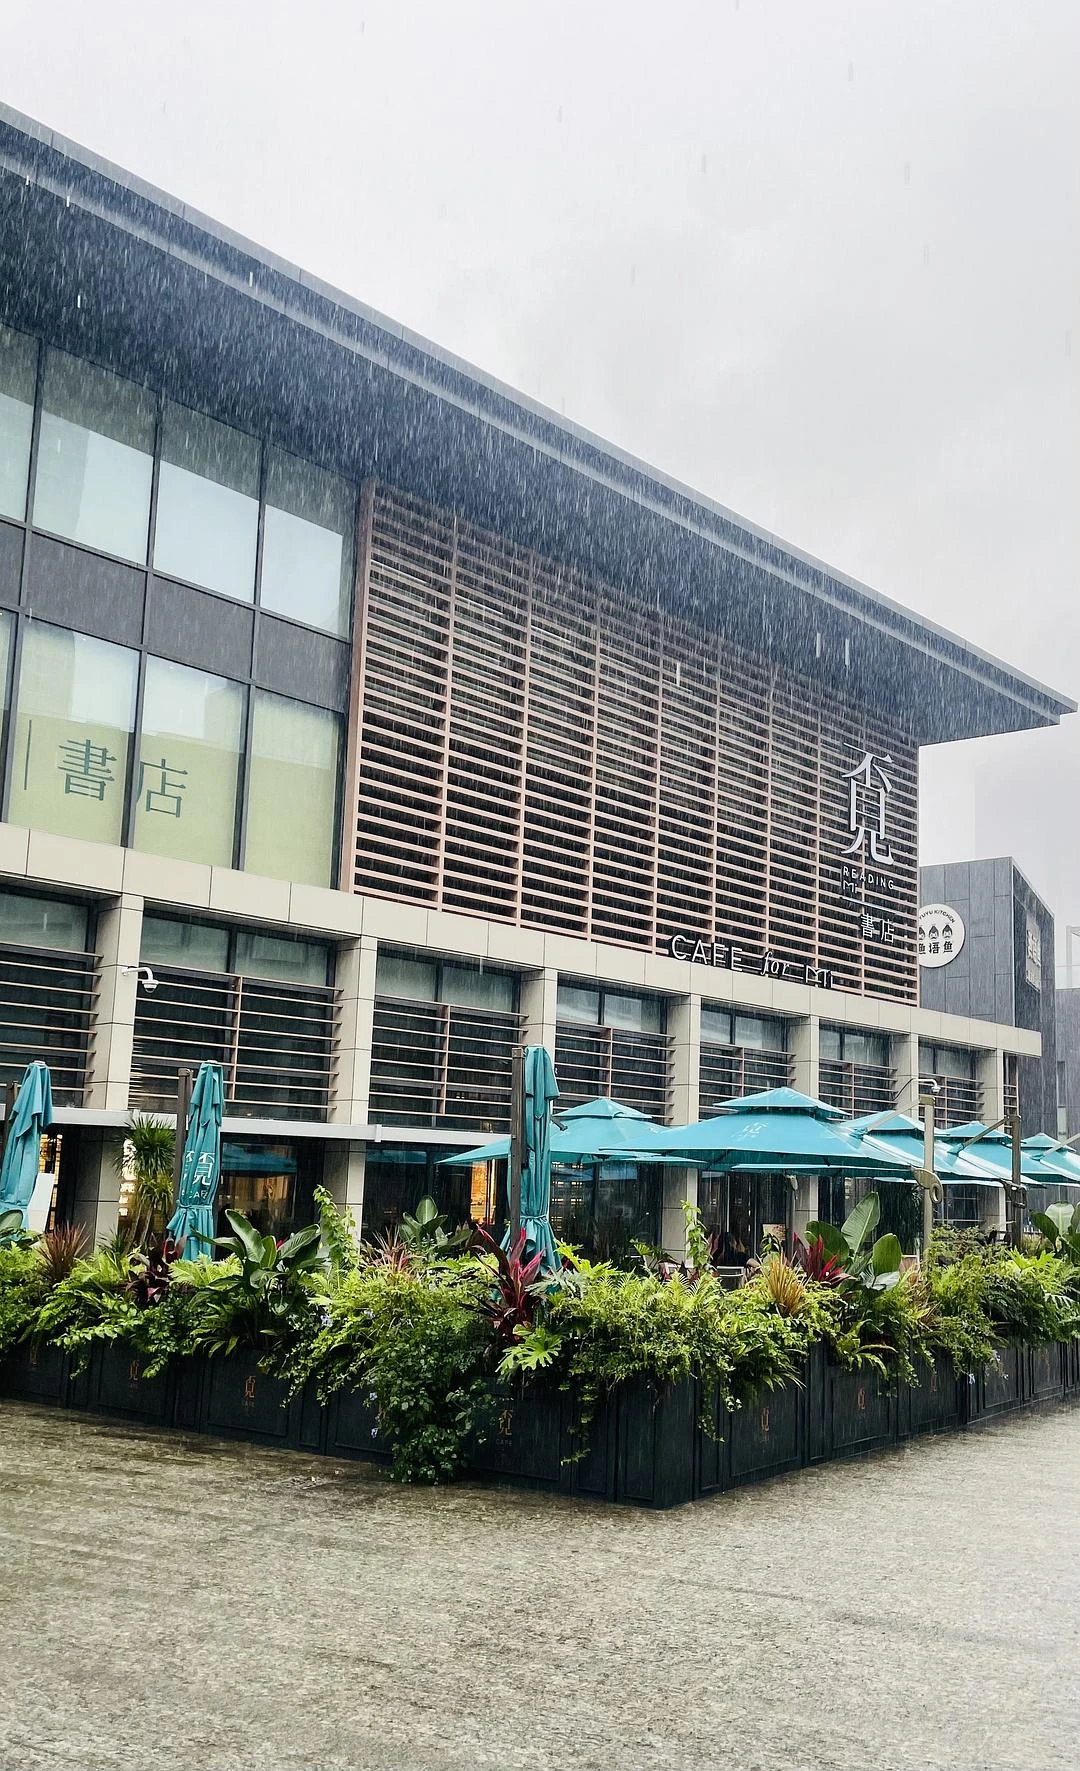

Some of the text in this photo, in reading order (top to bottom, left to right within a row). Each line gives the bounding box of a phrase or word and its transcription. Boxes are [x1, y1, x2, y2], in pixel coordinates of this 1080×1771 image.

[57, 739, 188, 818] 書店
[843, 866, 895, 890] READING
[860, 913, 895, 943] 書店
[671, 934, 743, 972] CAFE
[760, 949, 791, 976] for
